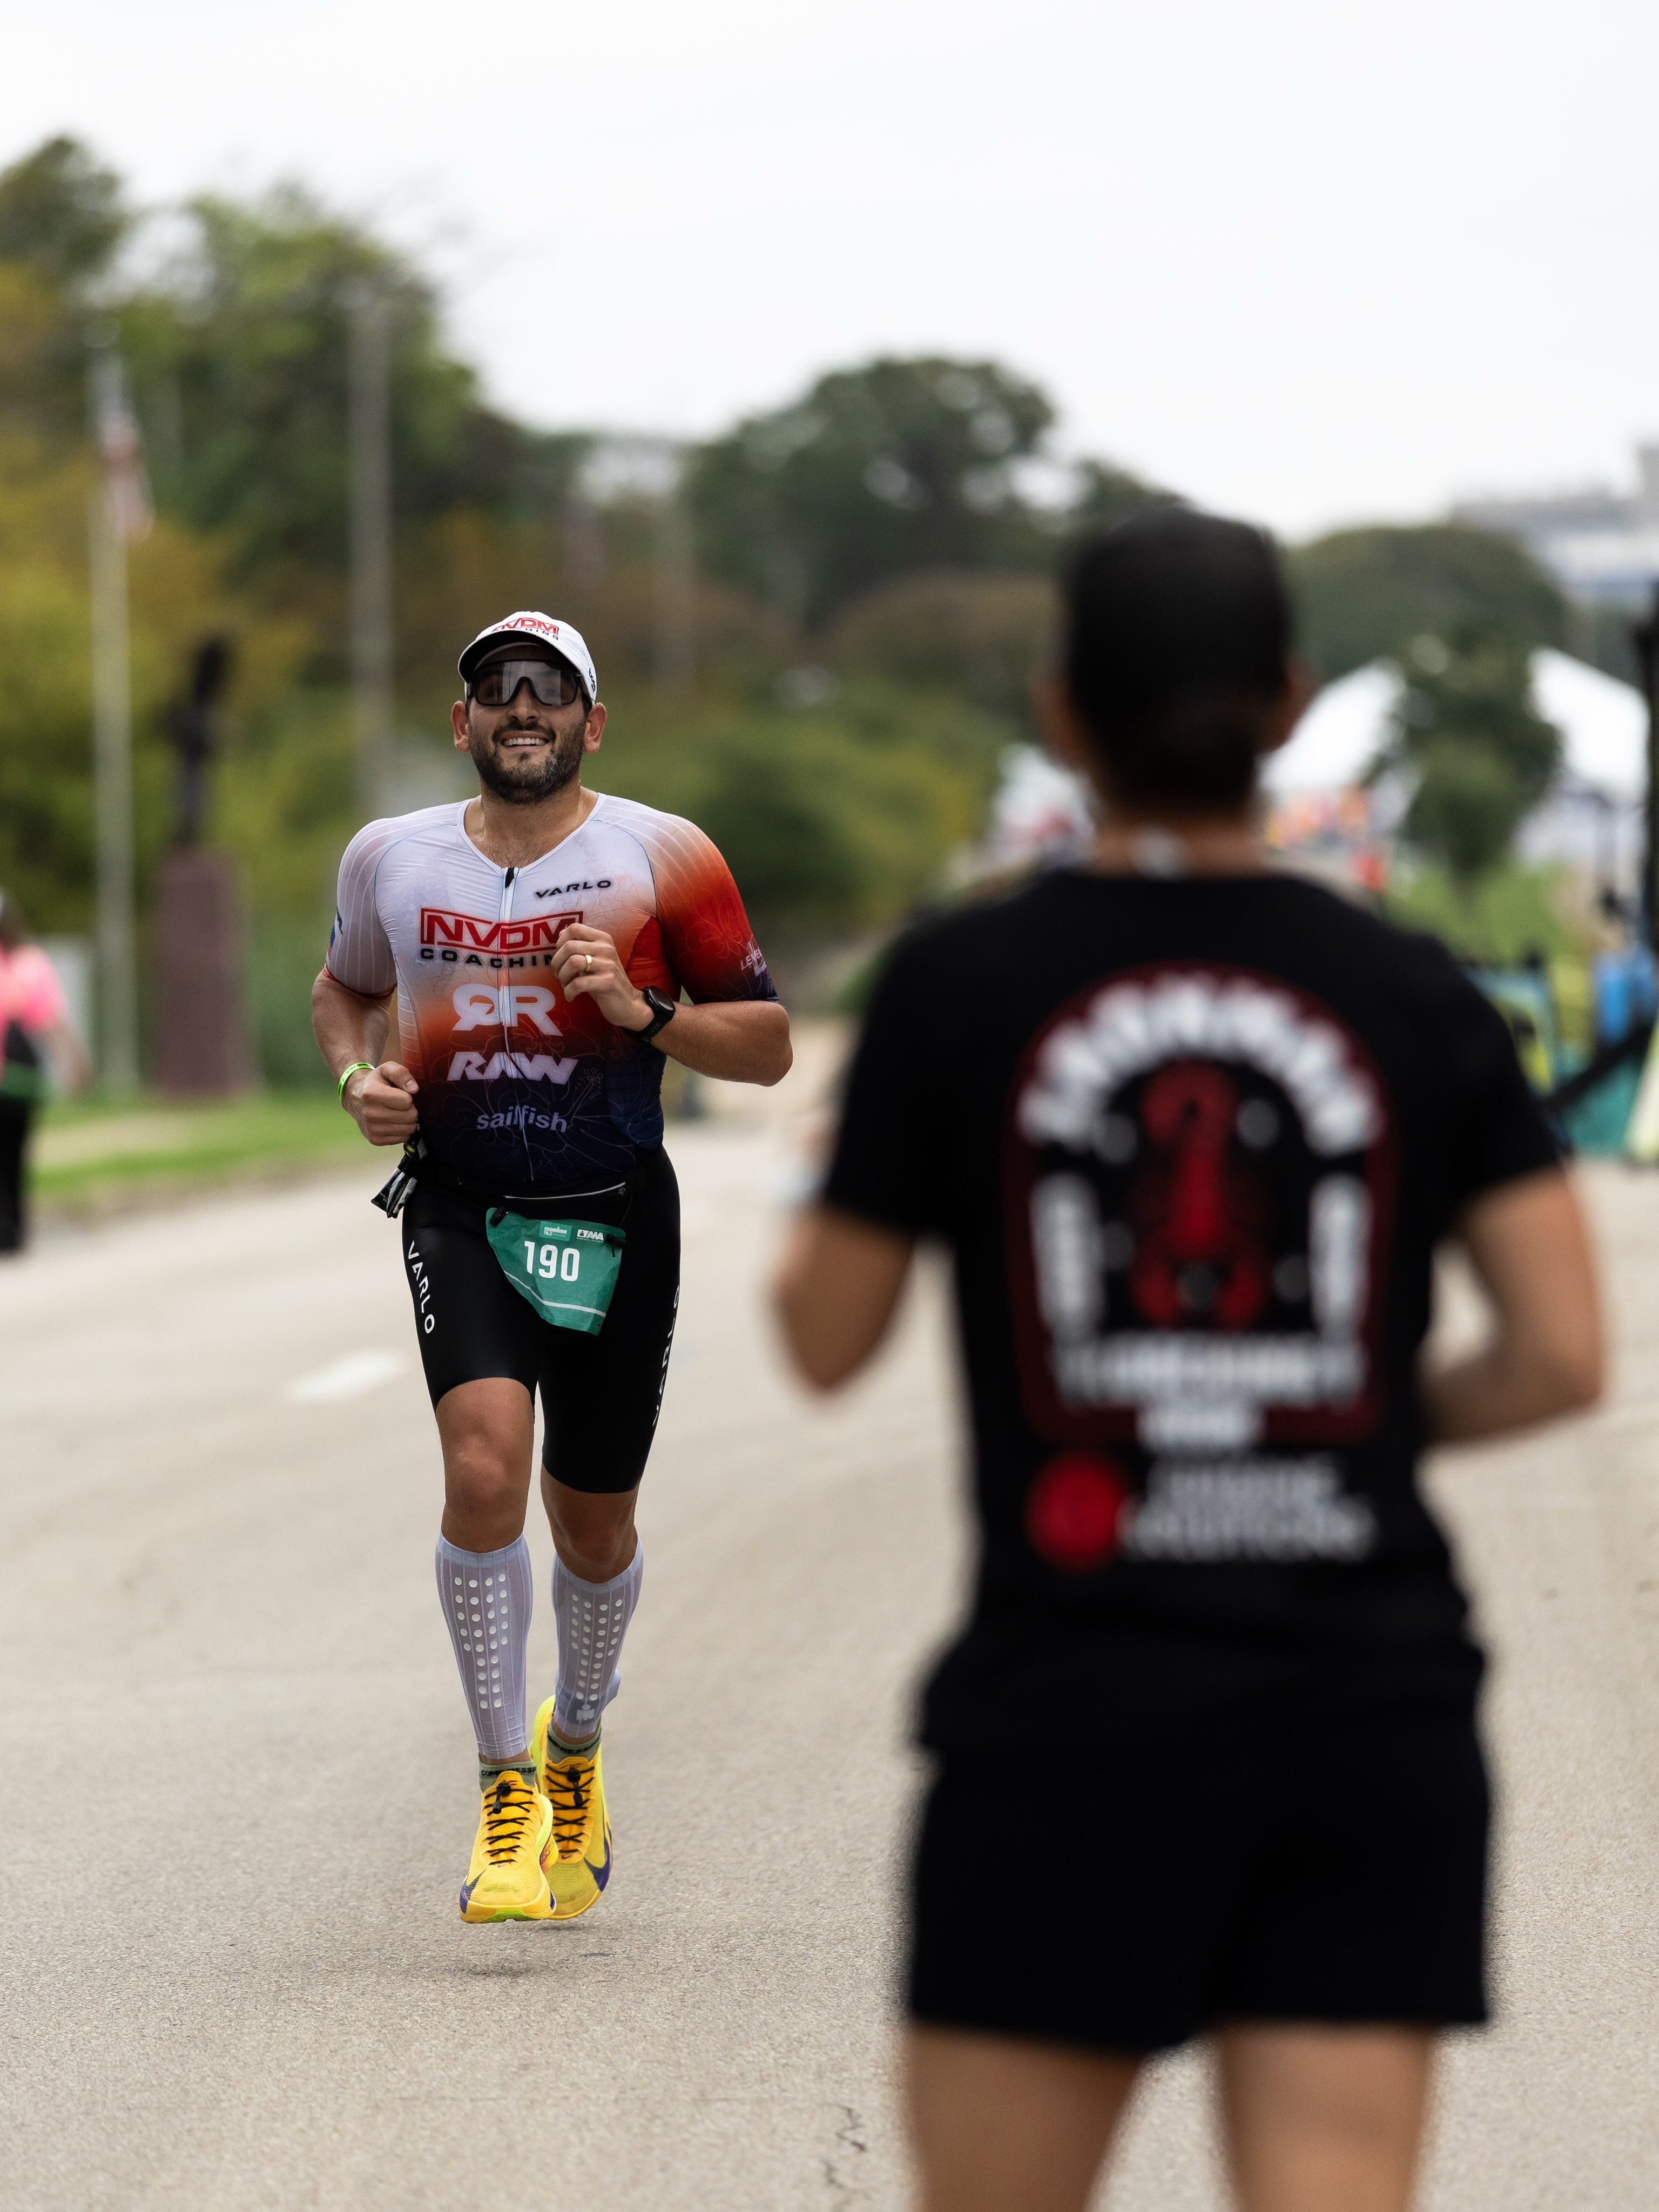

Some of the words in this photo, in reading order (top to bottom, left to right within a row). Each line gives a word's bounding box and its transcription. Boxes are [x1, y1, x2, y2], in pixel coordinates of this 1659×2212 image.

[535, 880, 611, 898] VARLO
[427, 914, 576, 949] NVDM
[421, 948, 552, 968] COACHIN
[452, 983, 563, 1037] QR
[447, 1051, 579, 1085] RAW
[476, 1105, 567, 1132] sailfish
[524, 1240, 580, 1282] 190
[408, 1240, 435, 1334] VARLO
